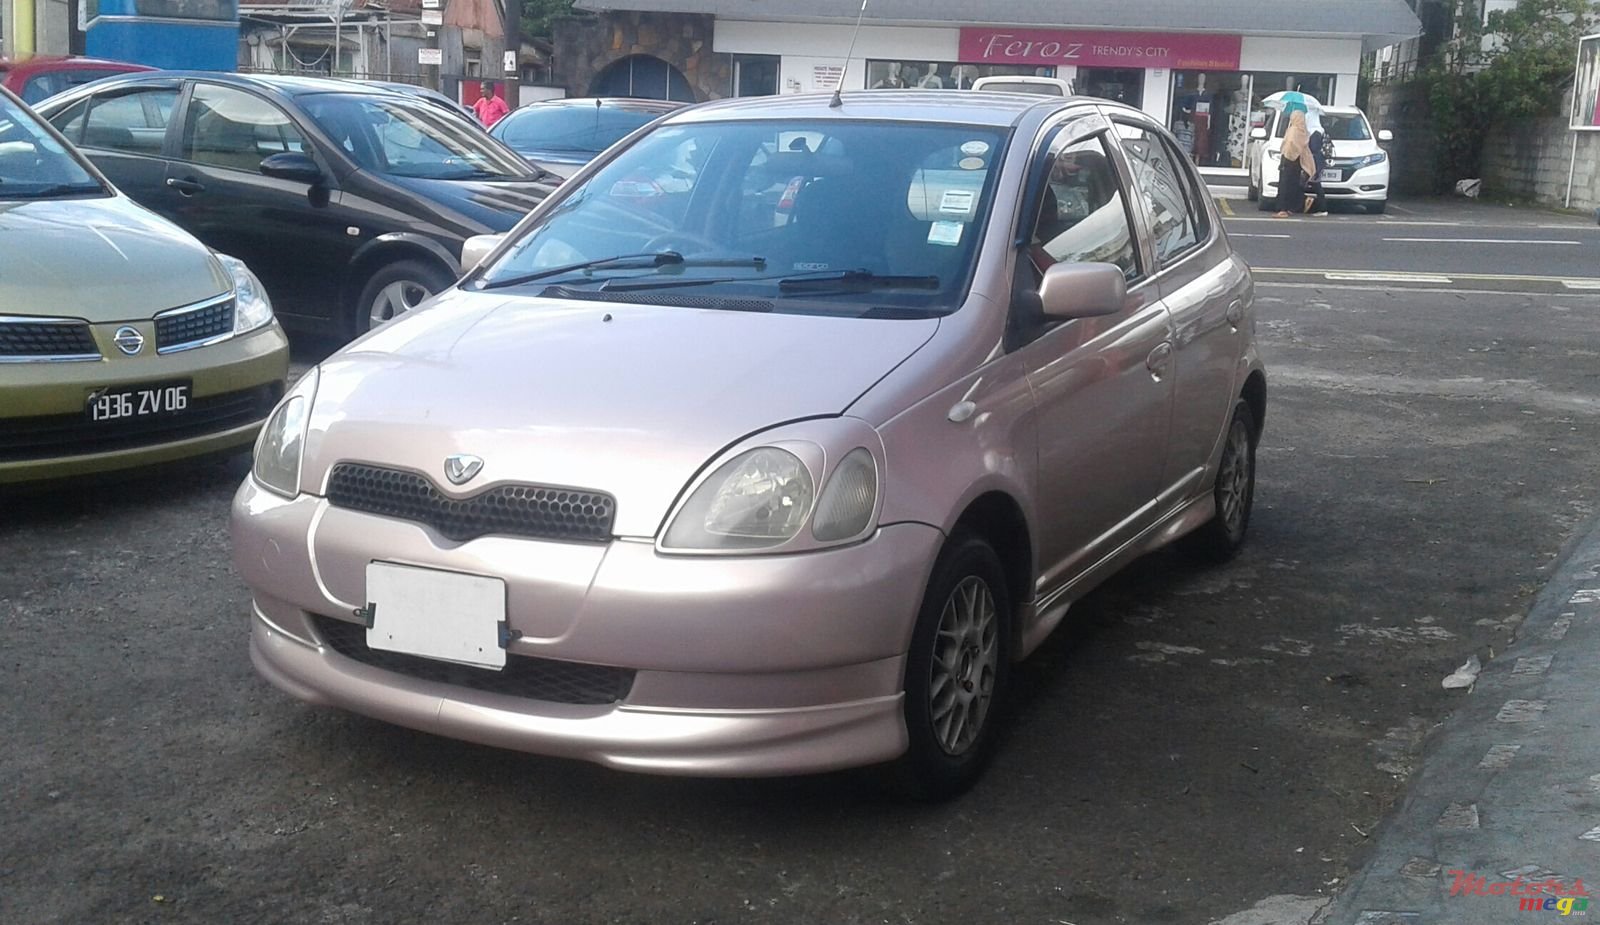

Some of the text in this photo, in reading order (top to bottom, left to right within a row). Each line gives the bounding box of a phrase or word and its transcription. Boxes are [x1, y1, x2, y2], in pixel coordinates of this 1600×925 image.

[979, 34, 1084, 58] Feroz
[1092, 45, 1170, 57] TRENDY'S CITY
[92, 386, 188, 420] 1936 ZV 06
